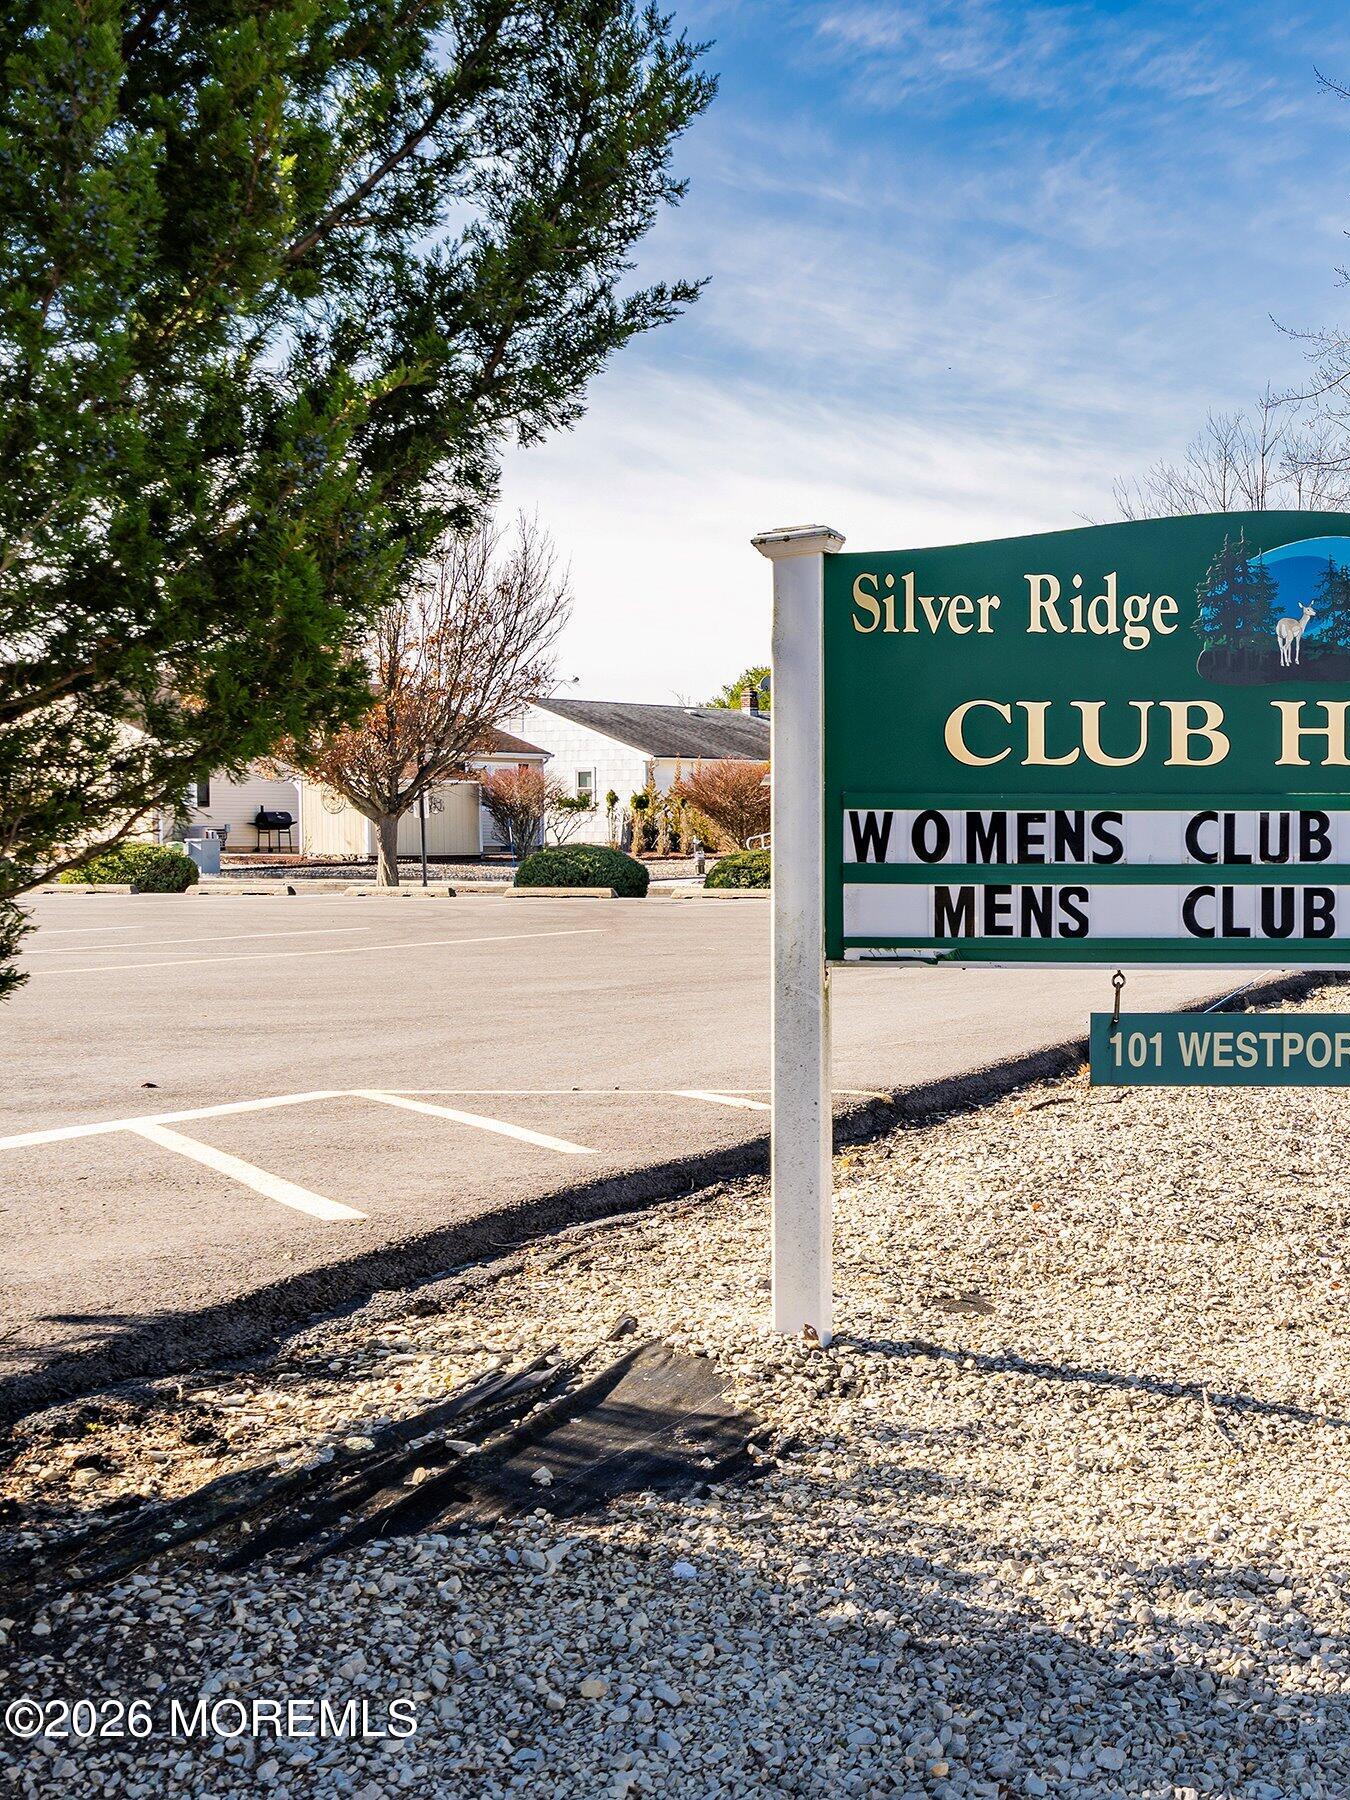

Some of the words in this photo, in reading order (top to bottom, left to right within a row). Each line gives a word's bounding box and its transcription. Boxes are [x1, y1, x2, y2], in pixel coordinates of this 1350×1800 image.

[852, 571, 1001, 634] Silver
[1023, 571, 1179, 650] Ridge
[944, 700, 1231, 767] CLUB
[849, 810, 1124, 864] WOMENS
[1185, 810, 1332, 864] CLUB
[934, 885, 1089, 938] MENS
[1182, 885, 1336, 939] CLUB
[1109, 1032, 1163, 1067] 101
